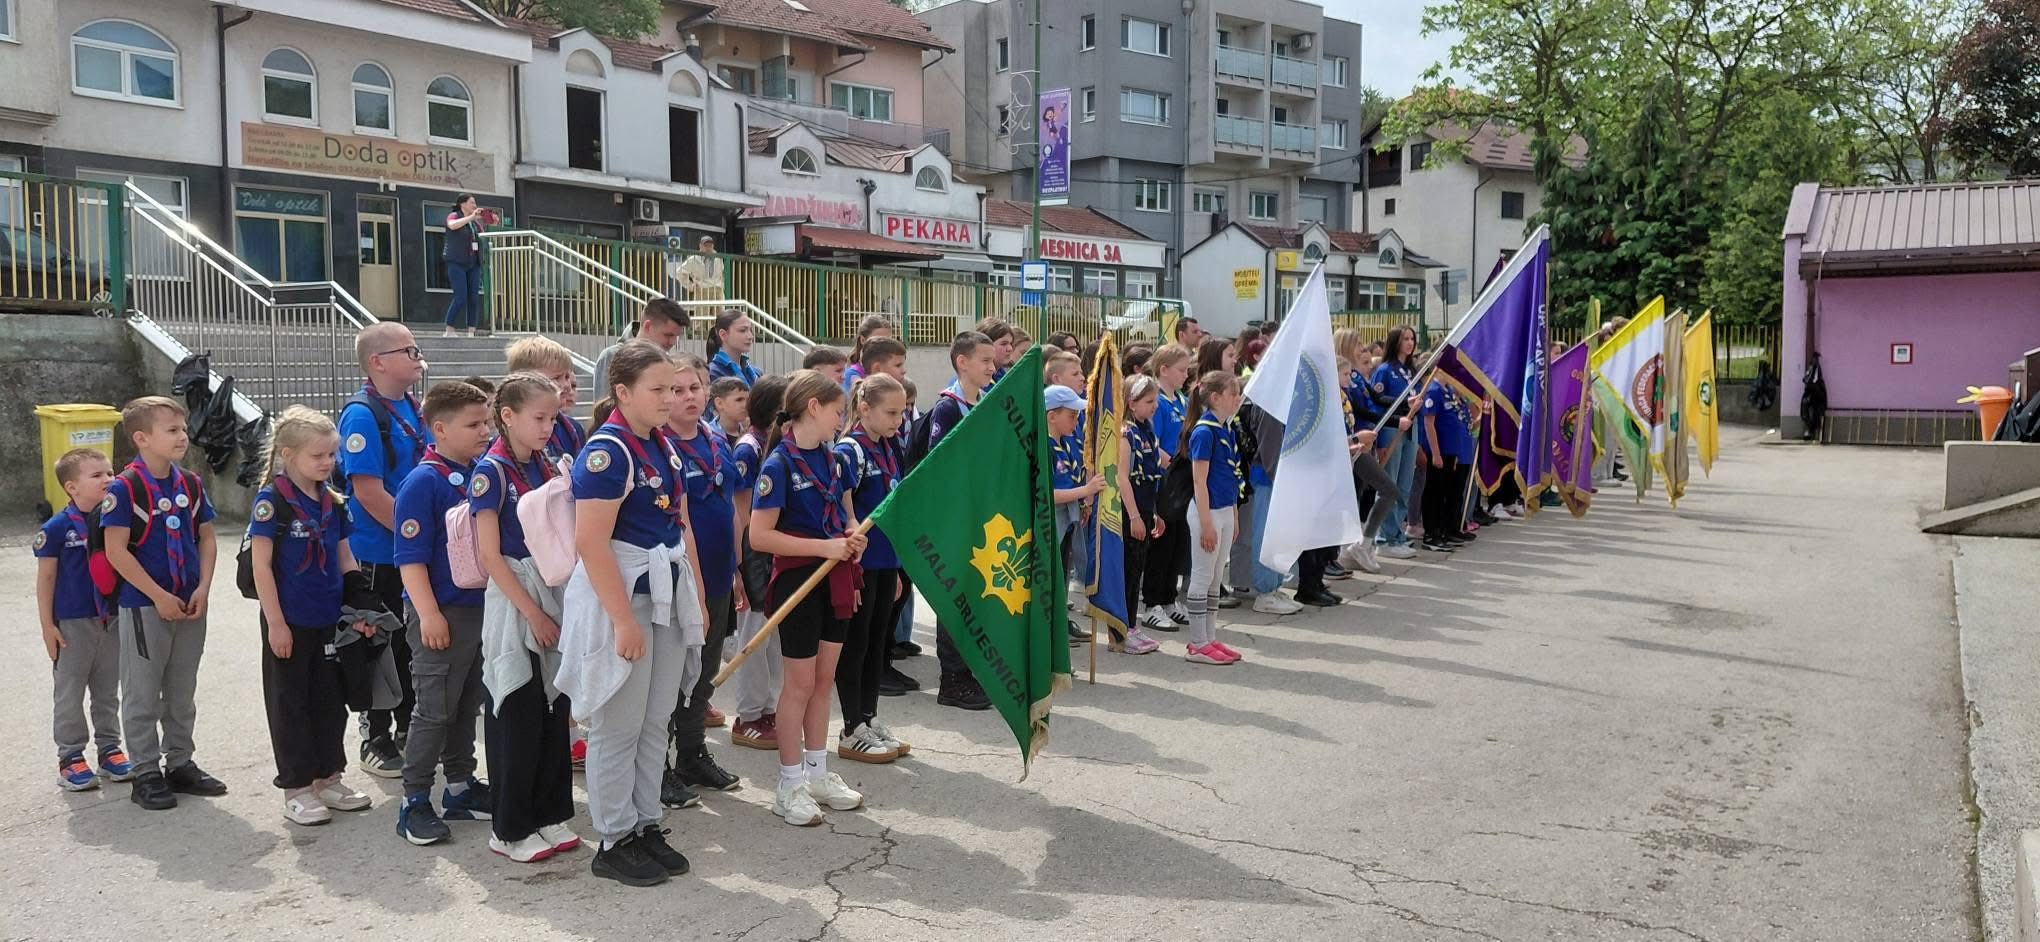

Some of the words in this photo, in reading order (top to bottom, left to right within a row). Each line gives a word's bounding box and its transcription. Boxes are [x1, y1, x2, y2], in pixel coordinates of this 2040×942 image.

[324, 136, 388, 164] Doda
[397, 149, 457, 173] optik
[887, 216, 971, 244] PEKARA
[1040, 238, 1099, 261] MESNICA
[1104, 244, 1122, 263] 3A
[914, 533, 957, 593] MALA
[954, 591, 1027, 708] BRIJESNICA
